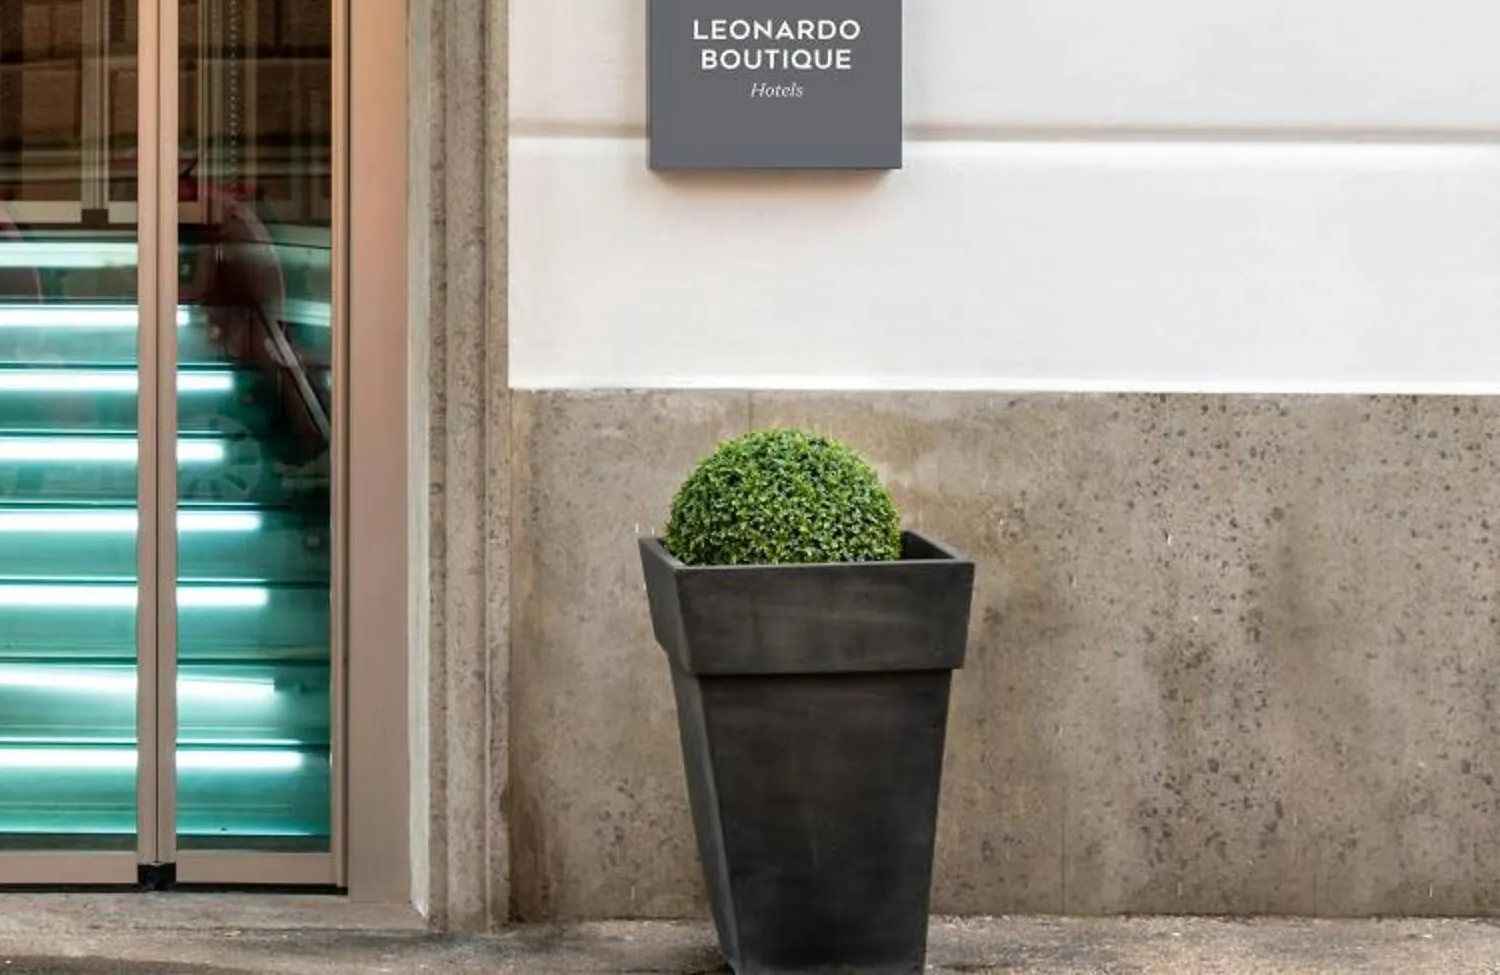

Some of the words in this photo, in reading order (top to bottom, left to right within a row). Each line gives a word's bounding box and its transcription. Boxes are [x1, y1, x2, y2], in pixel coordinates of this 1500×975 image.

[693, 18, 861, 41] LEONARDO
[701, 48, 852, 70] BOUTIQUE
[751, 82, 804, 98] Hotels
